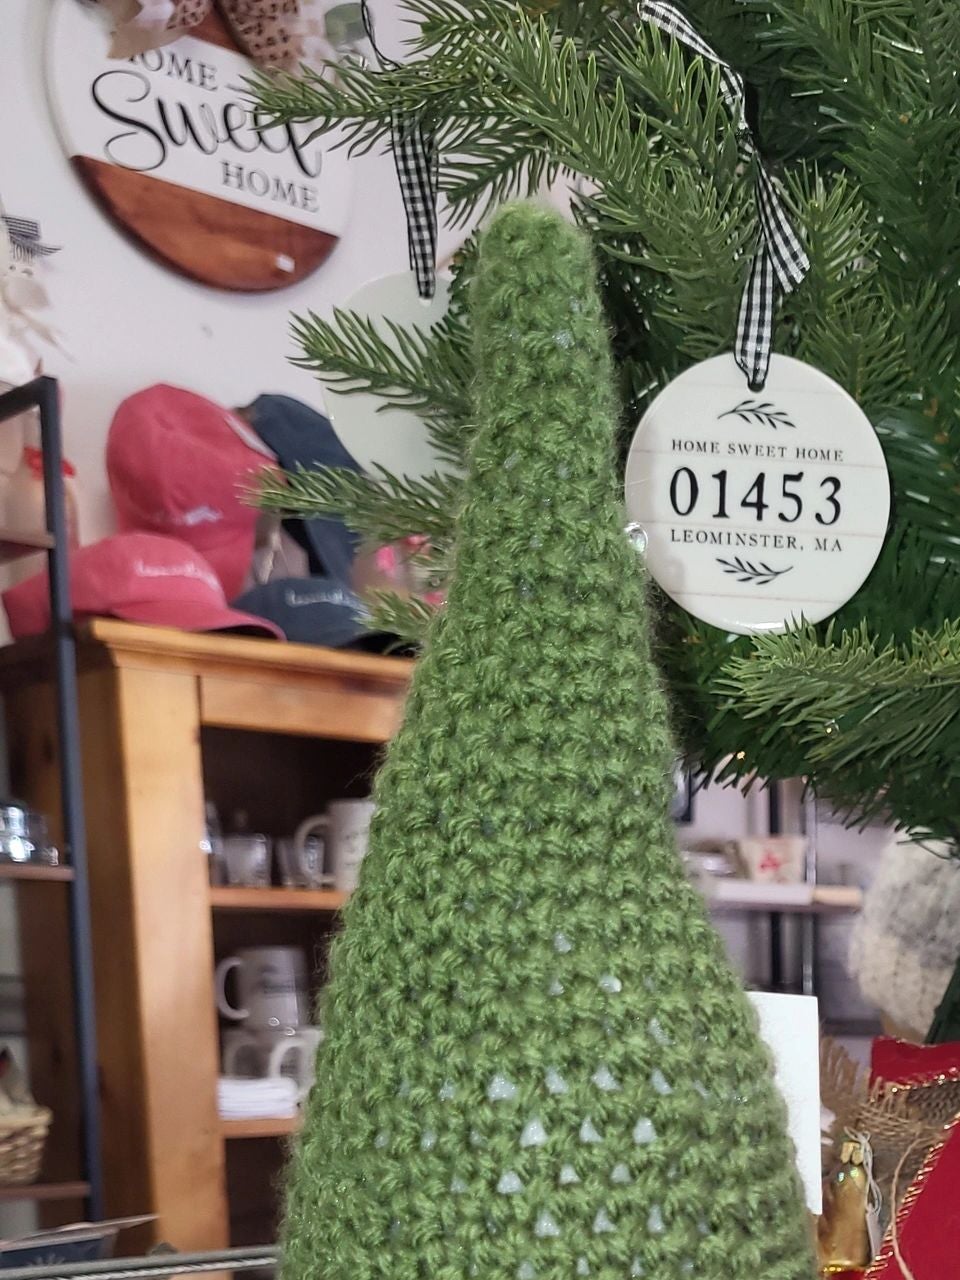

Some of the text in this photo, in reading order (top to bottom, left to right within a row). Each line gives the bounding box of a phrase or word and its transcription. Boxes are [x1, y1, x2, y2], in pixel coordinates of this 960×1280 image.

[128, 48, 218, 92] OME
[220, 159, 320, 213] HOME
[672, 438, 844, 462] HOME SWEET HOME
[669, 466, 842, 525] 01453
[670, 528, 843, 552] LEOMINSTER, MA
